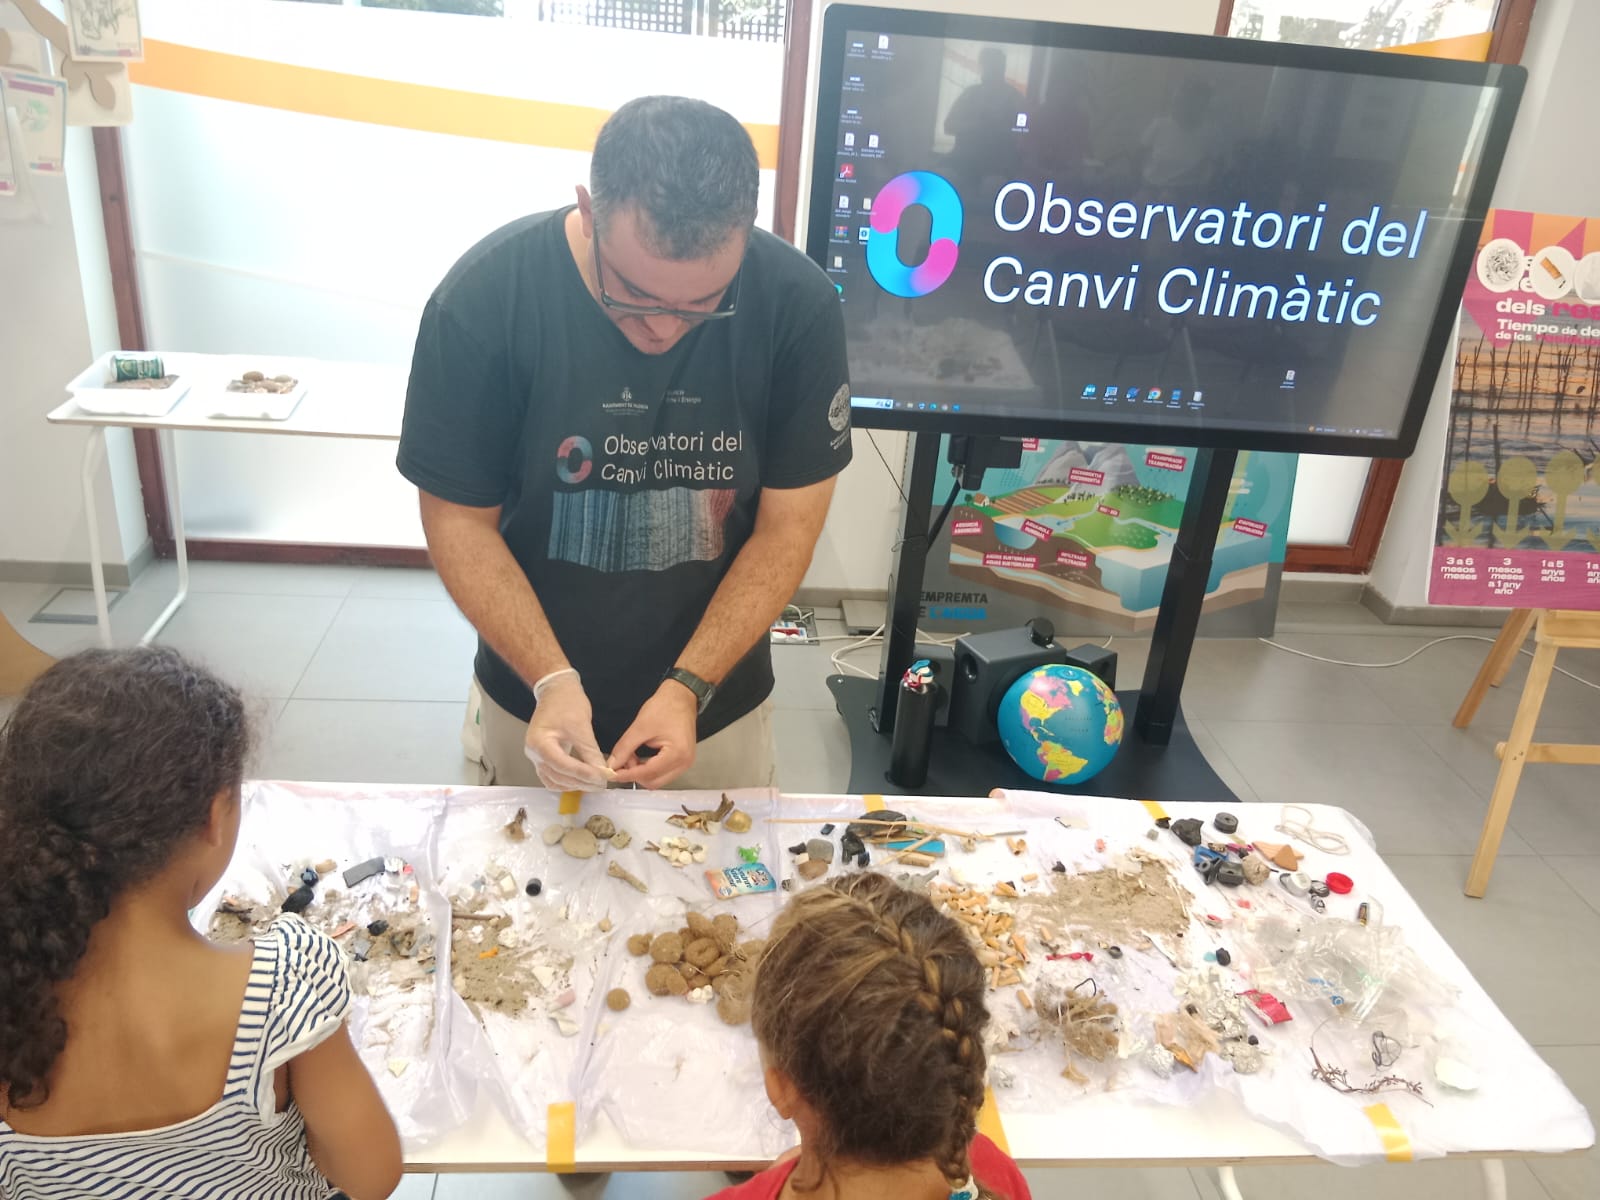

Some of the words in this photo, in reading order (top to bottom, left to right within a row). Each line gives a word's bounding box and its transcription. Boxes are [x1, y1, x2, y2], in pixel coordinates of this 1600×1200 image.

[993, 182, 1327, 253] Observatori
[1342, 206, 1428, 260] del
[983, 256, 1139, 312] Canvi
[1158, 268, 1382, 328] Climàtic
[1496, 298, 1546, 316] dels
[1497, 318, 1559, 334] Tiempo
[1562, 326, 1578, 336] de
[1495, 331, 1512, 340] de
[1513, 332, 1532, 341] los
[604, 431, 704, 456] Obsevatori
[711, 429, 743, 453] del
[601, 461, 647, 485] Canvi
[653, 458, 735, 481] Climàtic
[1446, 556, 1455, 565] 3
[1456, 558, 1464, 566] a
[1465, 557, 1474, 566] 6
[1503, 557, 1512, 566] 3
[1541, 559, 1546, 567] 1
[1556, 560, 1564, 568] 5
[1585, 561, 1591, 569] 1
[1440, 566, 1476, 574] mesos
[1487, 566, 1523, 574] mesos
[1540, 568, 1566, 576] anys
[1443, 573, 1478, 581] meses
[1490, 573, 1525, 581] meses
[1540, 575, 1566, 583] años
[1497, 580, 1502, 588] 1
[1502, 581, 1522, 590] any
[1494, 587, 1514, 595] año
